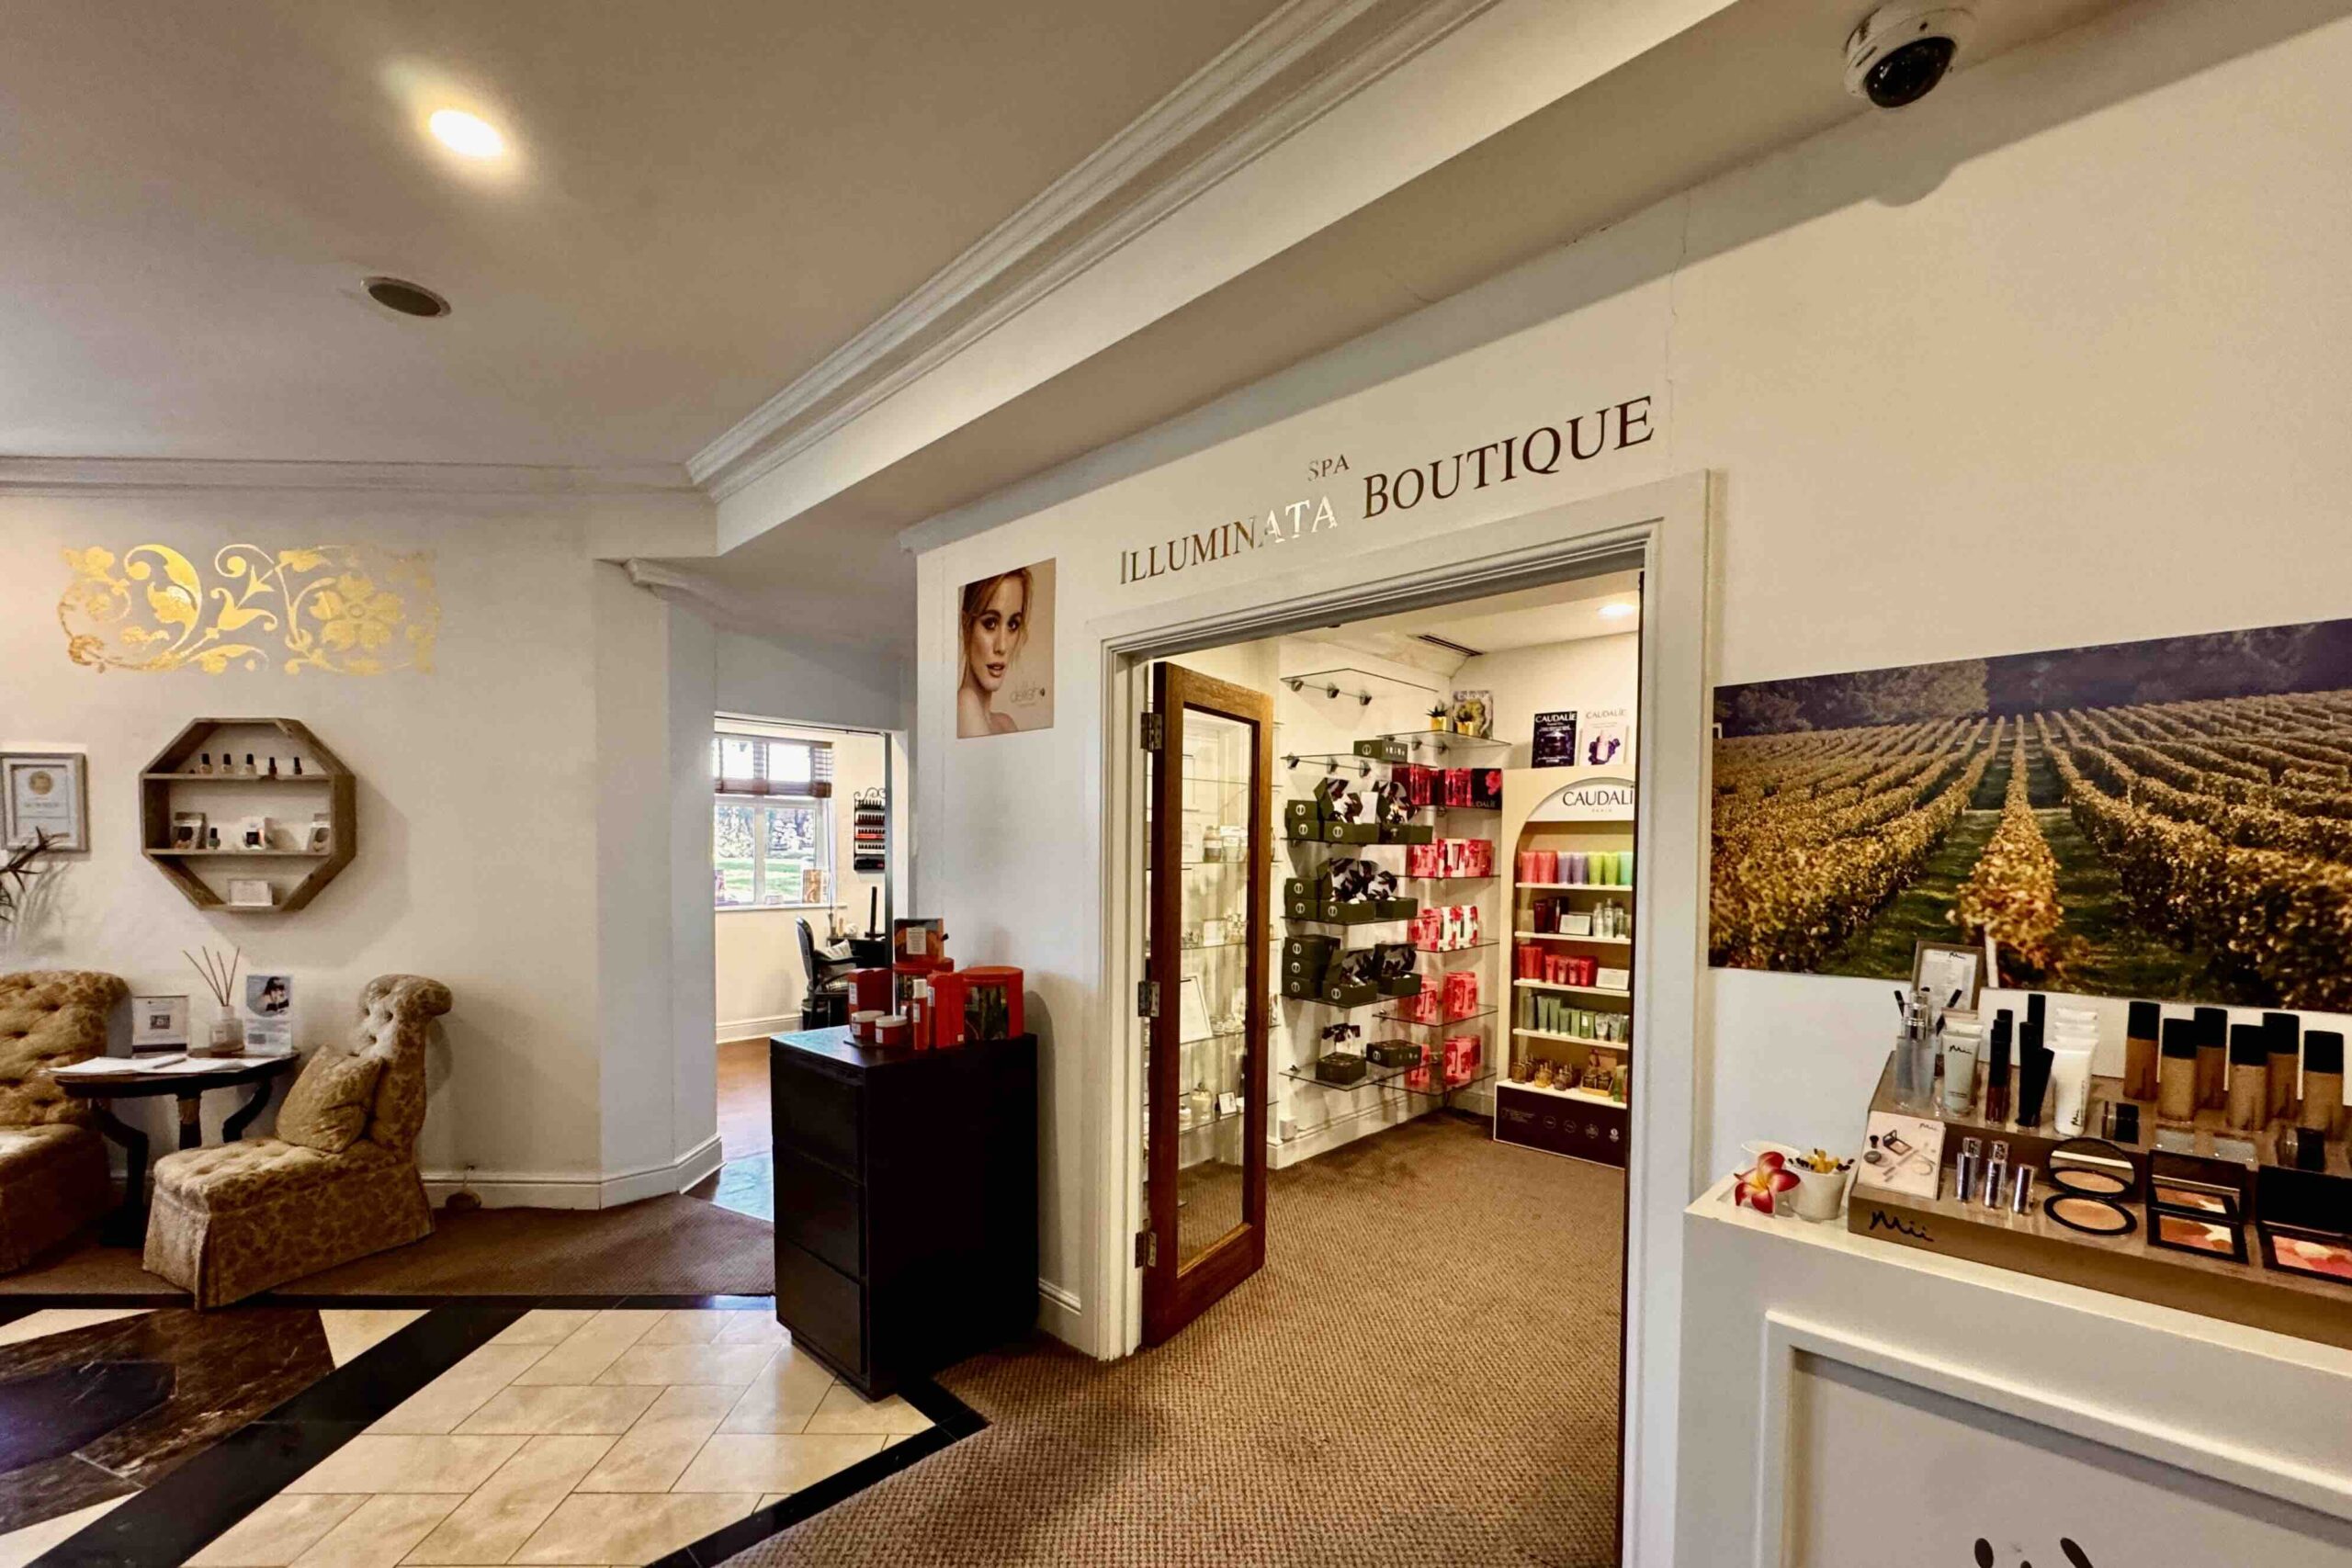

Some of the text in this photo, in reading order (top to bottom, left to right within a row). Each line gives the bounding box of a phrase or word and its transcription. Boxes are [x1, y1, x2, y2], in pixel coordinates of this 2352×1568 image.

[1306, 454, 1351, 482] SPA
[1120, 395, 1656, 585] ILLUMINATA BOUTIQUE
[1562, 786, 1634, 807] CAUDALI
[1869, 1210, 1935, 1243] Mii
